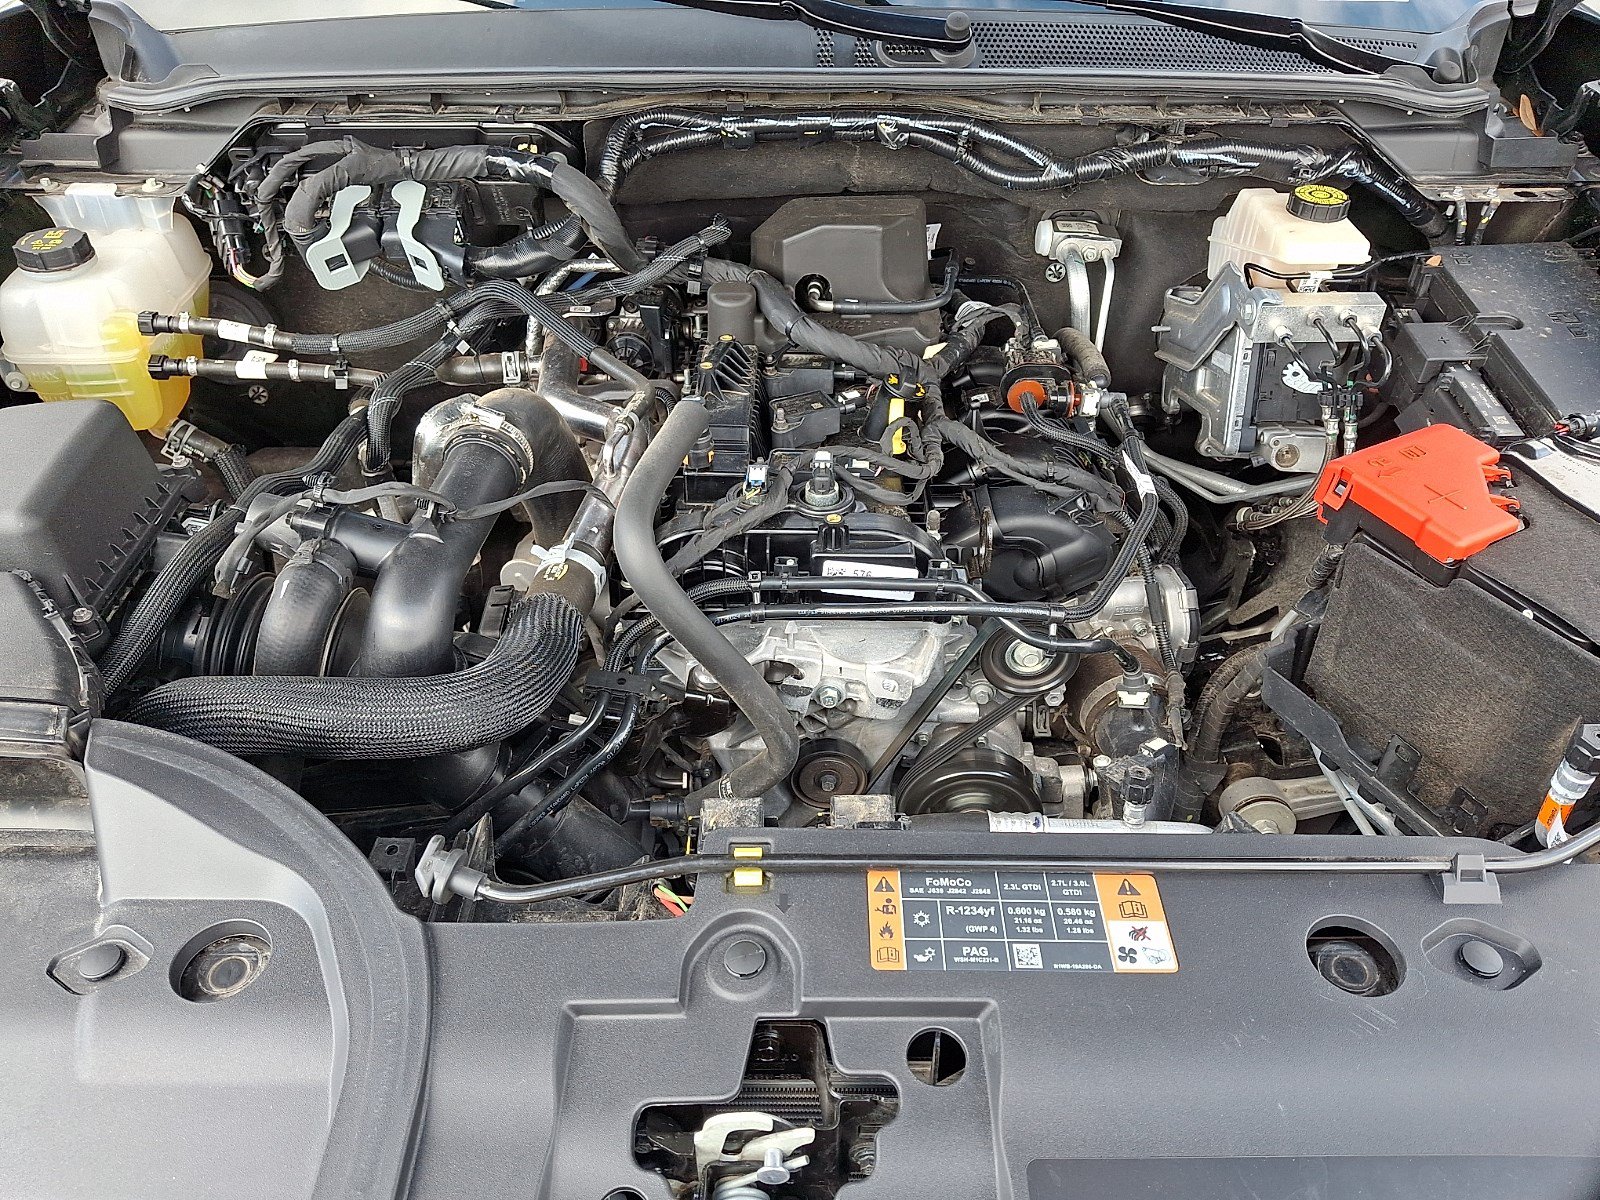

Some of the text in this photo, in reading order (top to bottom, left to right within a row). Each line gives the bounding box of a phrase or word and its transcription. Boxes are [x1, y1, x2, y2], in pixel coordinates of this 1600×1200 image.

[925, 877, 972, 887] FoMoCo
[1003, 883, 1021, 891] 2.3L
[1050, 879, 1068, 887] 2.7L
[946, 905, 996, 918] R-1234yf
[1007, 906, 1046, 917] 0.600 kg
[1056, 907, 1096, 918] 0.580 kg
[965, 924, 998, 935] (GWP 4)
[962, 946, 989, 957] PAG
